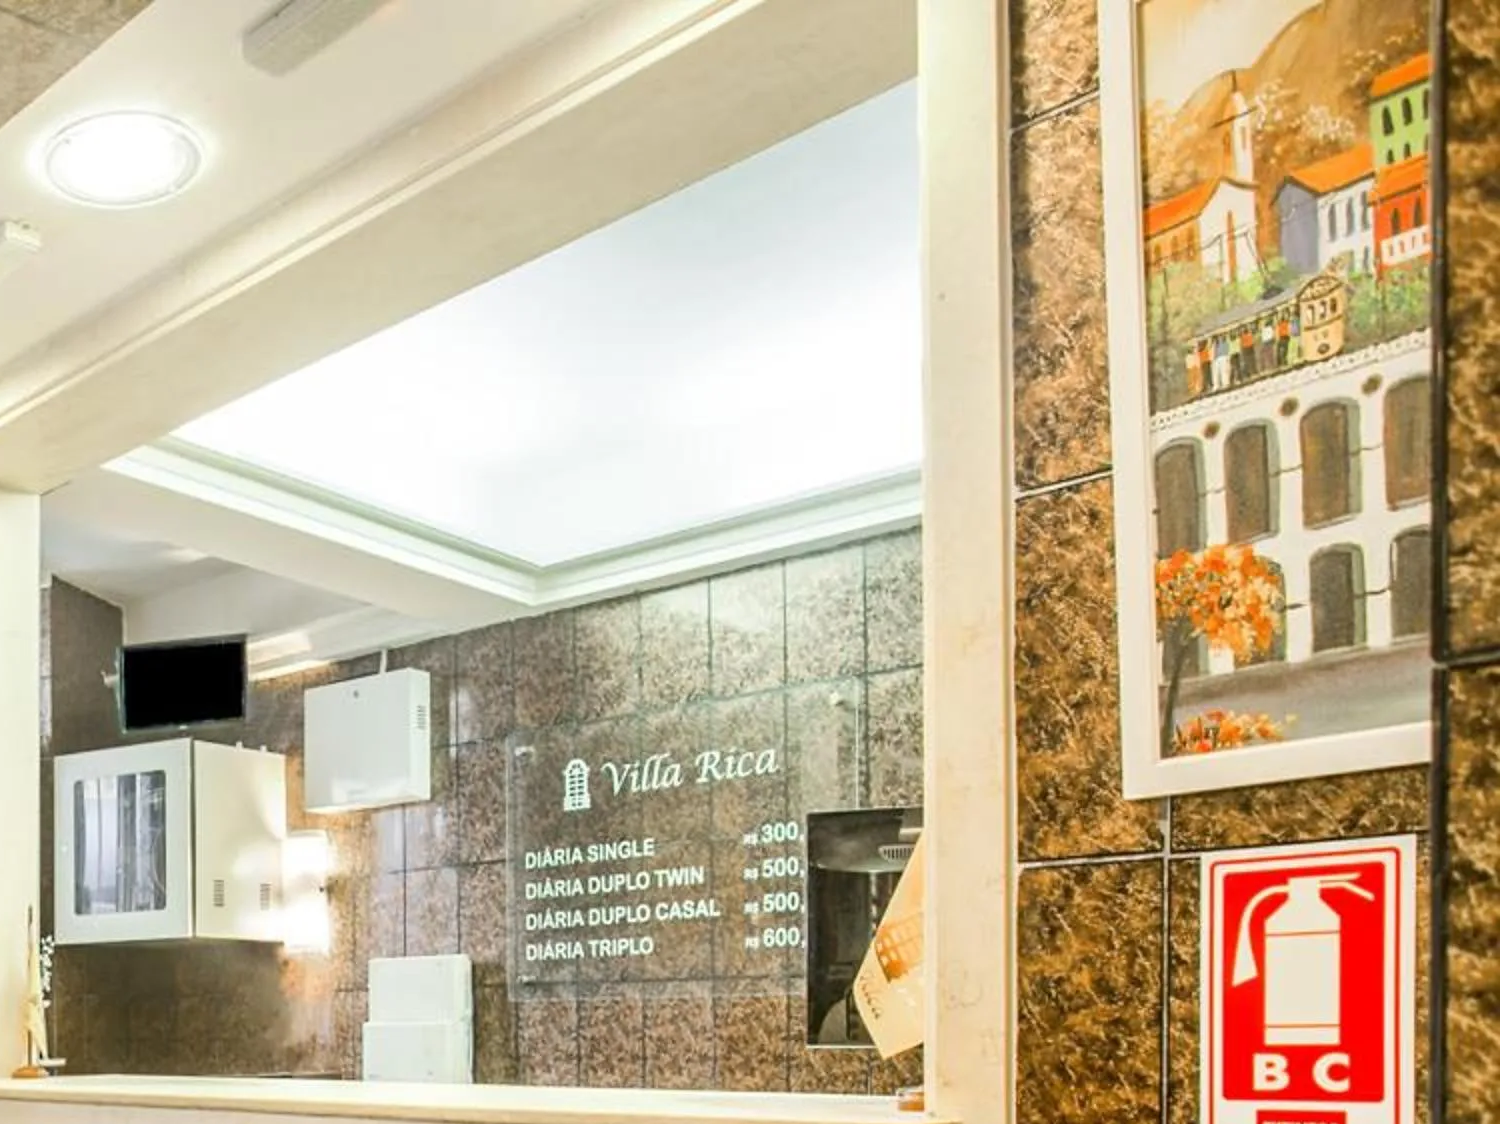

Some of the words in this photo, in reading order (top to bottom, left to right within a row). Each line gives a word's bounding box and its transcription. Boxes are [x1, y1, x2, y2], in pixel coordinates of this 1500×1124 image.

[600, 751, 684, 796] Villa
[695, 746, 780, 784] Rica
[524, 845, 584, 869] DIÁRIA
[587, 838, 656, 862] SINGLE
[524, 877, 584, 900] DIÁRIA
[587, 871, 651, 895] DUPLO
[654, 865, 705, 888] TWIN
[525, 908, 585, 931] DIÁRIA
[587, 903, 651, 926] DUPLO
[654, 898, 722, 921] CASAL
[525, 940, 585, 961] DIÁRIA
[587, 936, 655, 958] TRIPLO
[1252, 1052, 1290, 1092] B
[1312, 1052, 1351, 1092] C
